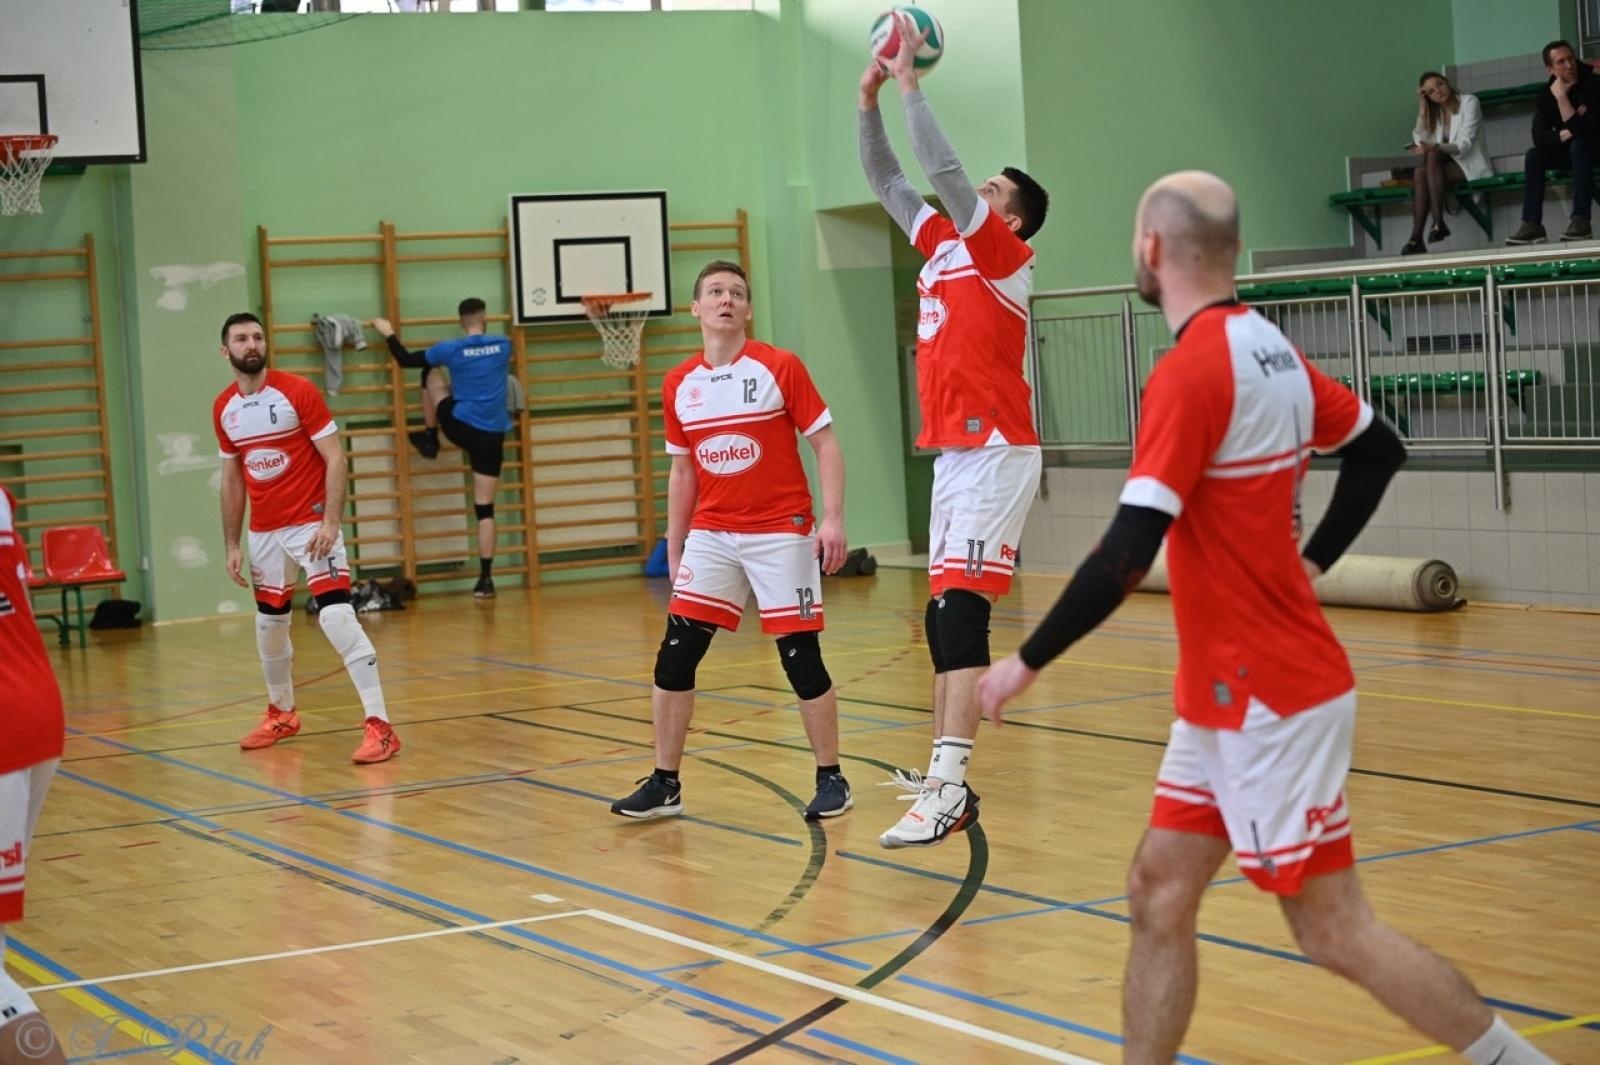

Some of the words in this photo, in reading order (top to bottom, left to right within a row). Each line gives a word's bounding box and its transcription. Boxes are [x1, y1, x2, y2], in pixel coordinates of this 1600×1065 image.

[743, 378, 758, 404] 12
[269, 404, 278, 425] 6
[699, 443, 755, 464] Henkel
[965, 539, 985, 578] 11
[796, 587, 816, 620] 12
